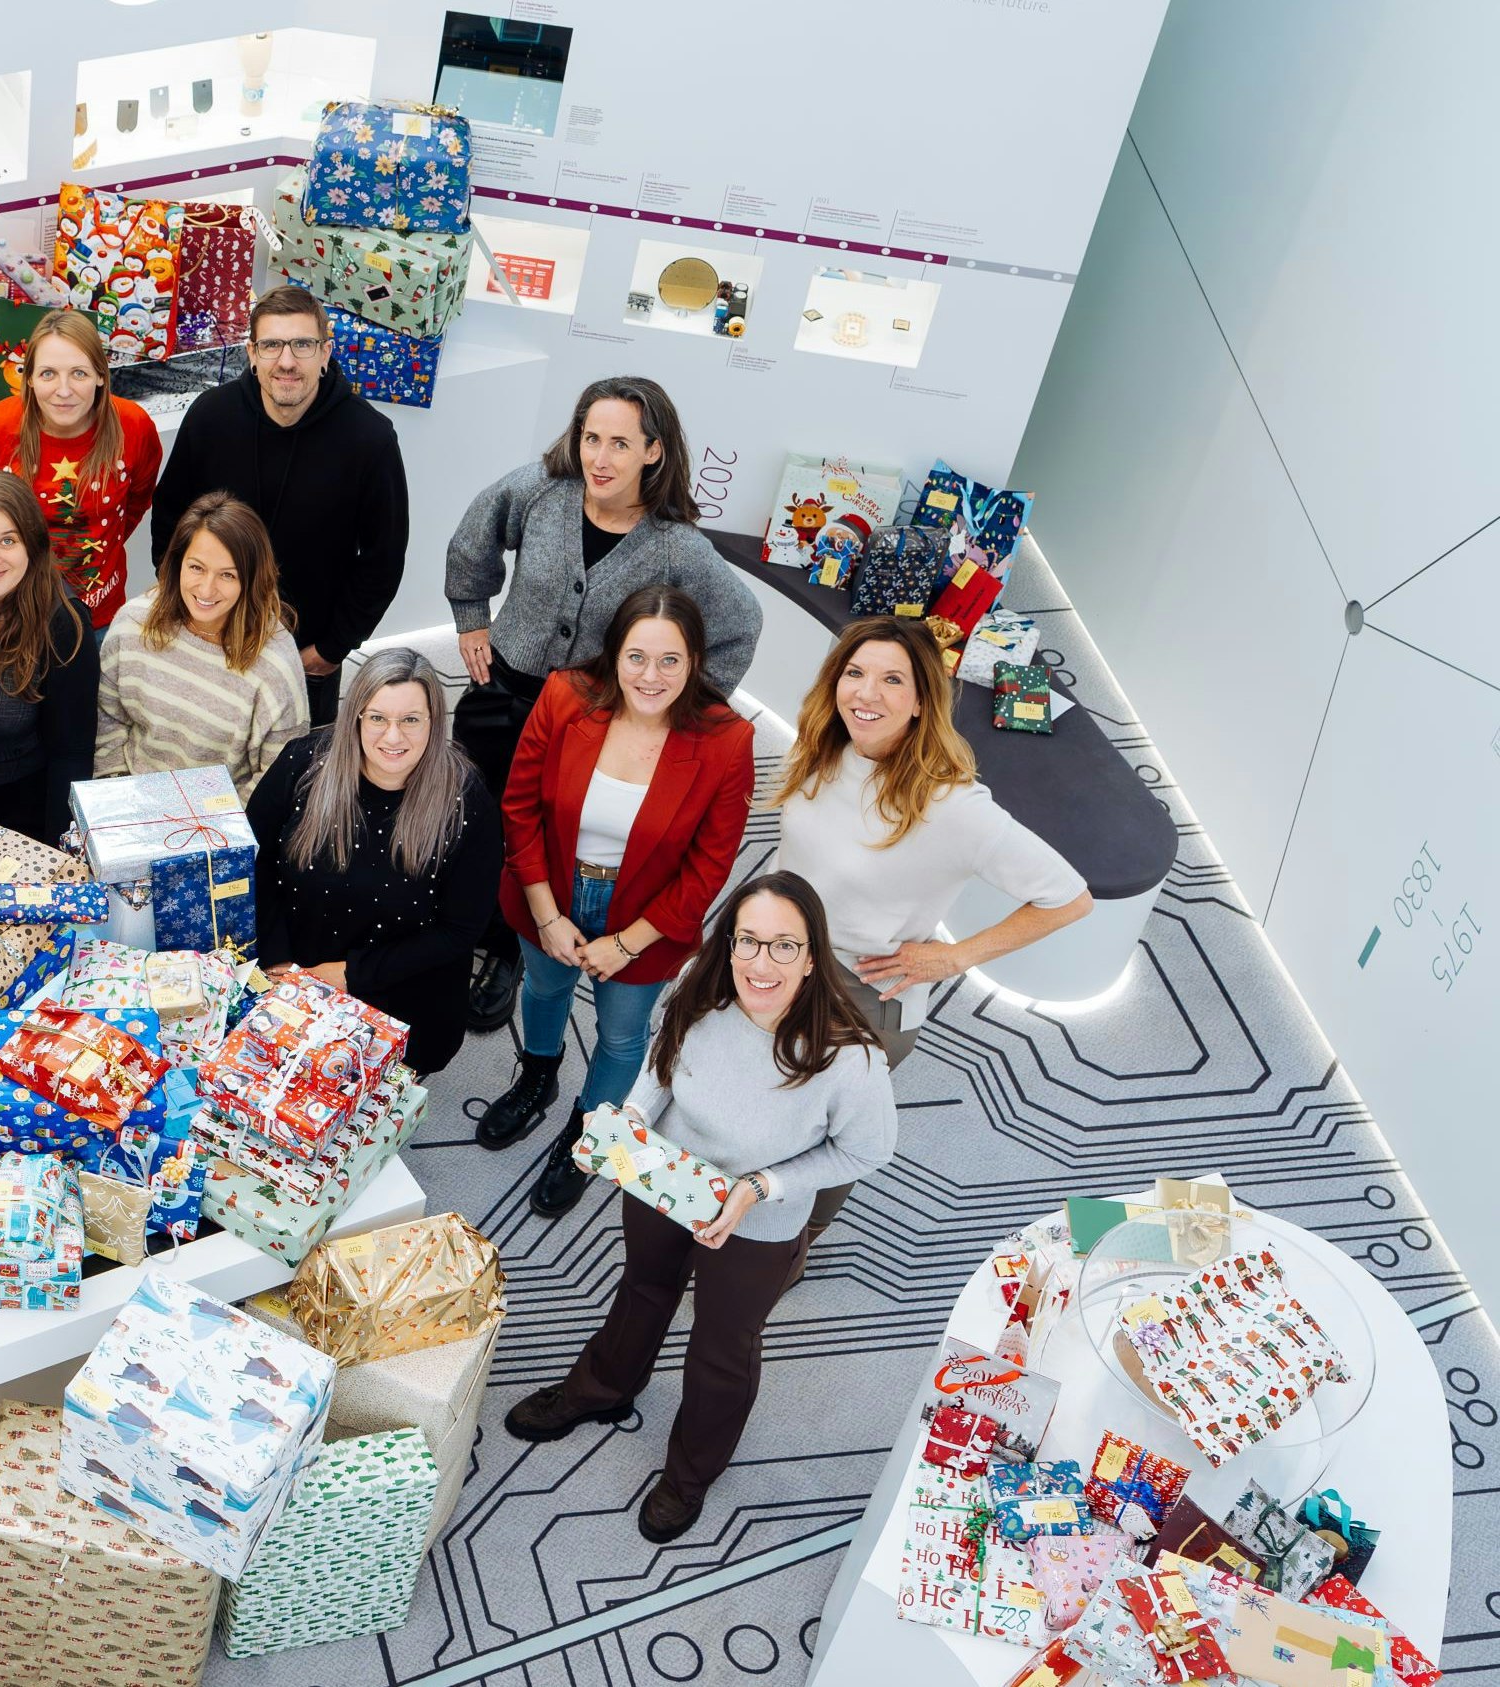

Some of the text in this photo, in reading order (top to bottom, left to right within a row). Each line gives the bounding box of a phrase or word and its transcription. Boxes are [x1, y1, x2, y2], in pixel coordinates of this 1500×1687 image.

[695, 447, 738, 518] 2020
[842, 493, 885, 524] CHRISTMAS
[855, 491, 882, 512] MERRY
[1393, 840, 1442, 928] 1830
[1431, 902, 1482, 992] 1975
[915, 1522, 936, 1536] HO
[917, 1550, 941, 1565] HO
[990, 1604, 1031, 1632] 728
